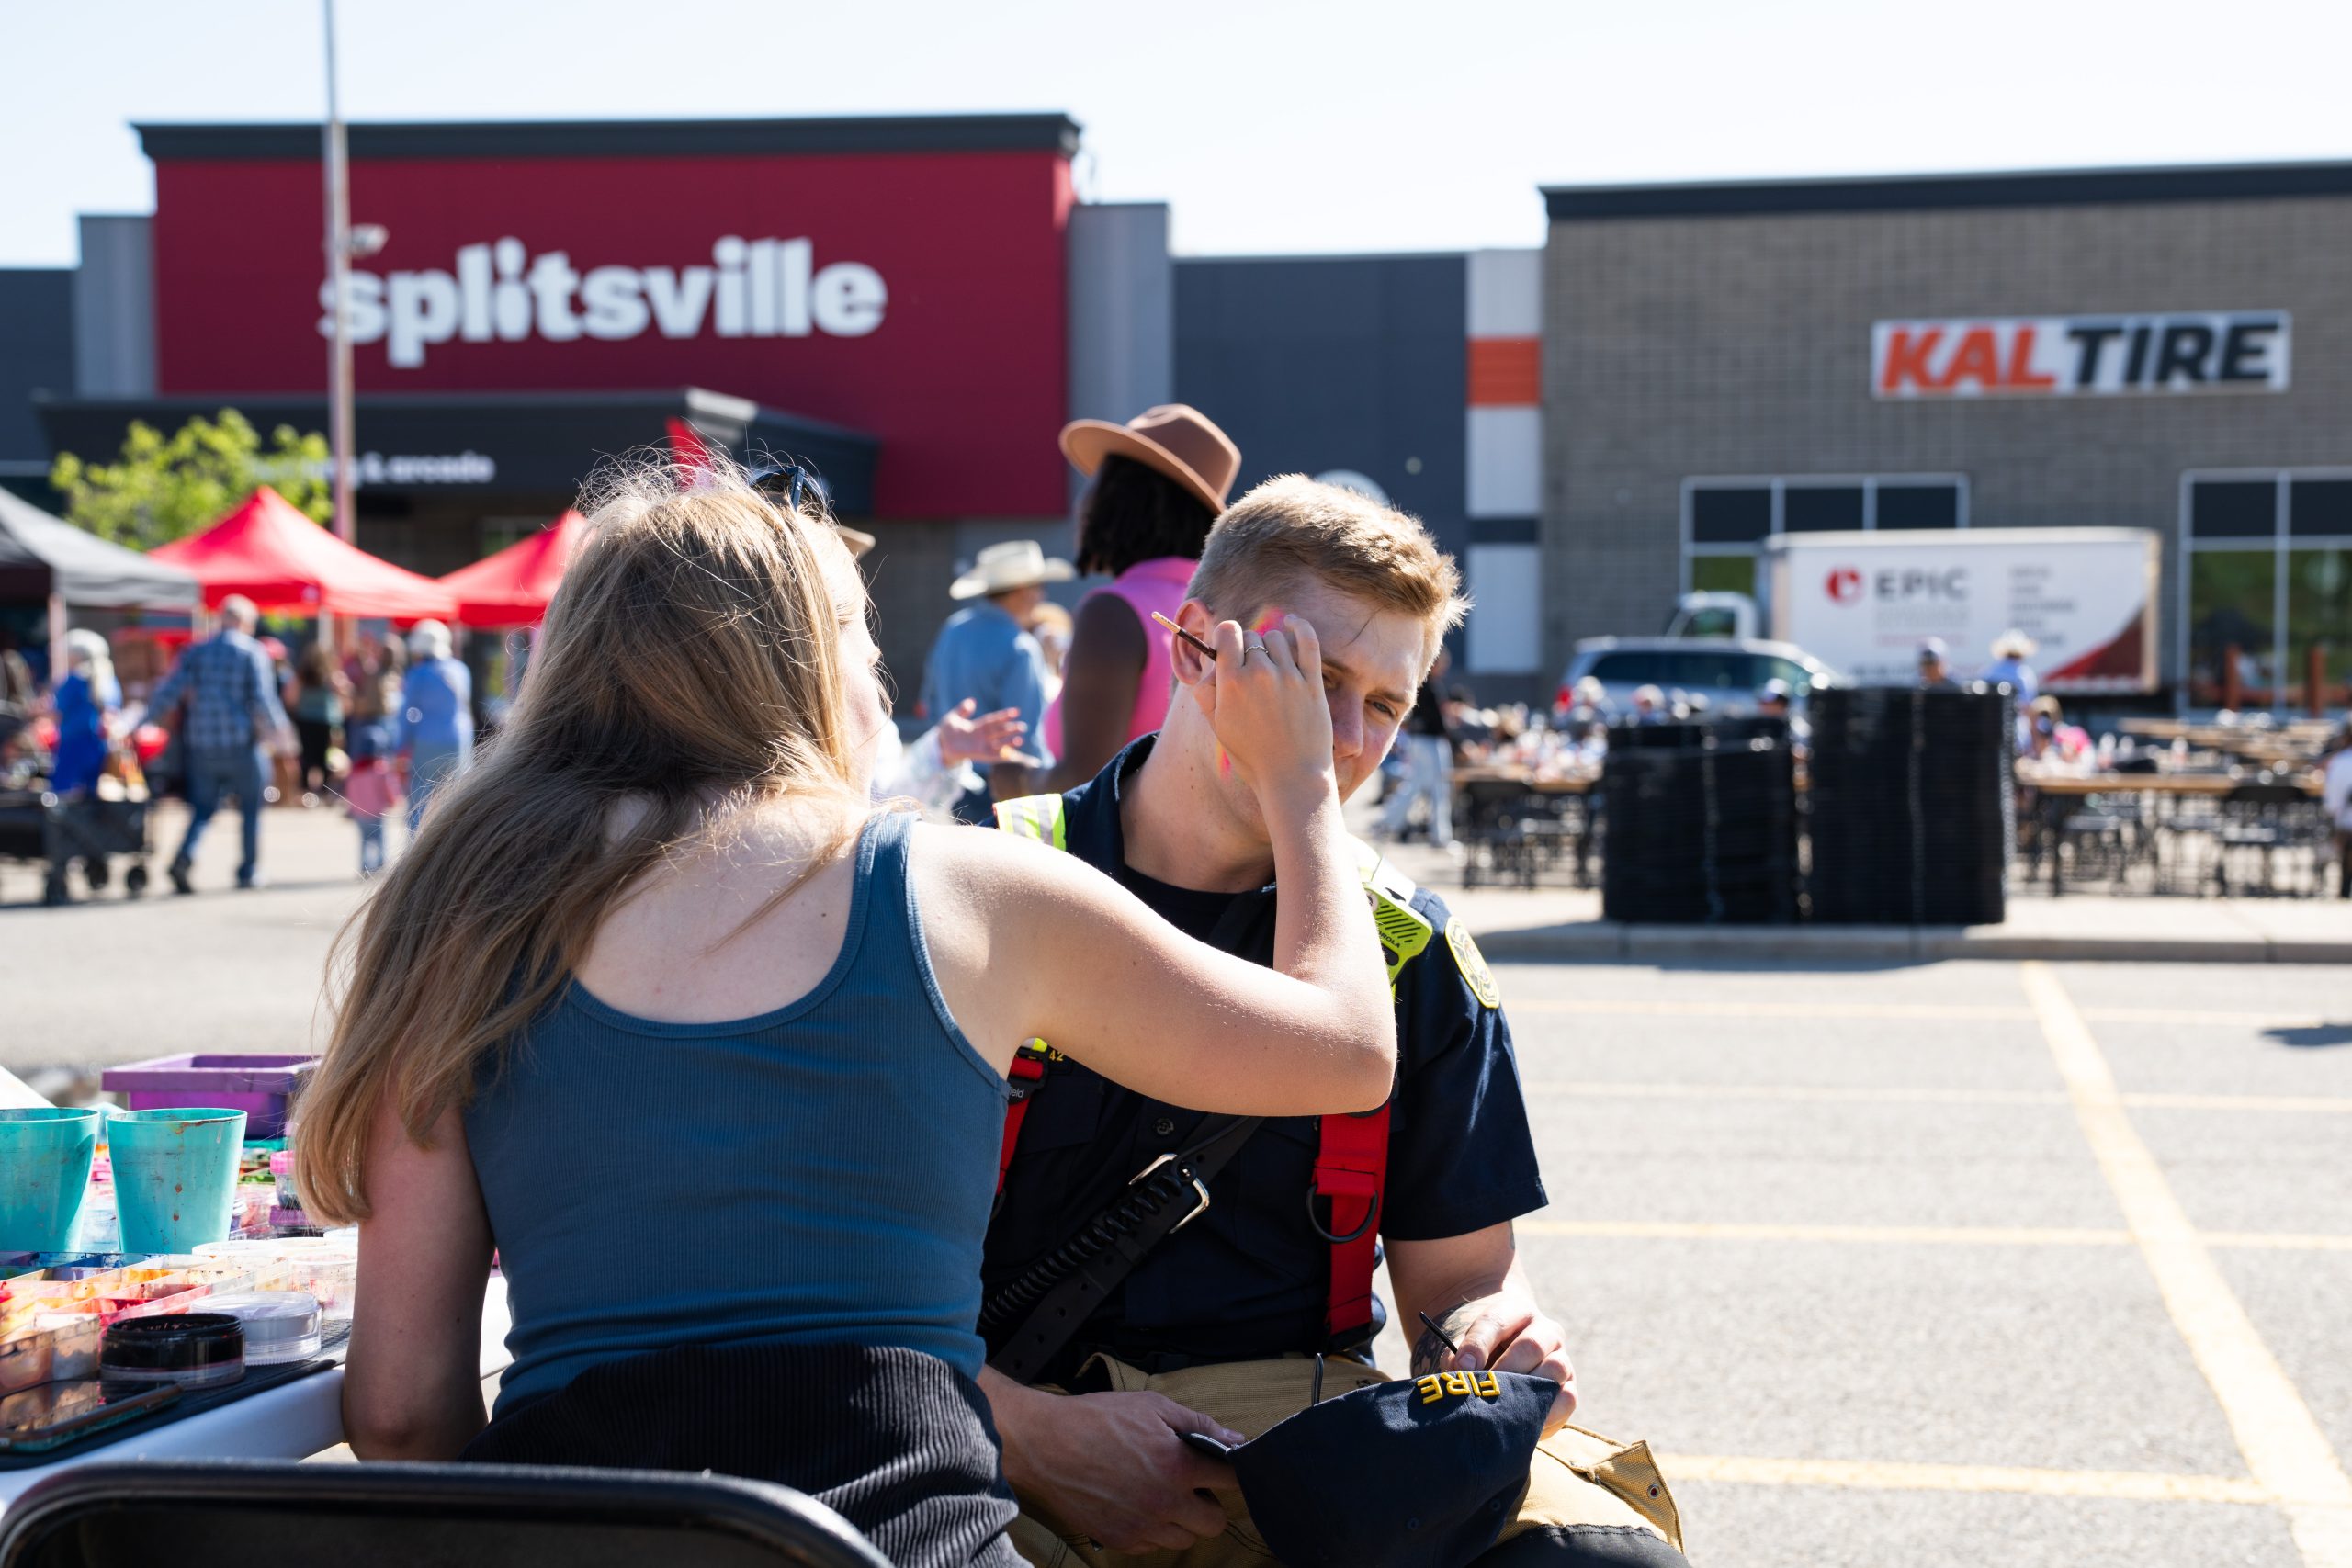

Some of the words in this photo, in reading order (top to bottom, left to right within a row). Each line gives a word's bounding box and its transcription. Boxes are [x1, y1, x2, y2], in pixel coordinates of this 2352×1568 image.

[318, 235, 888, 367] splitsville
[1881, 323, 2057, 391] KAL
[2067, 322, 2281, 386] TIRE
[1874, 567, 1971, 603] EPIC
[1417, 1371, 1501, 1404] FIRE
